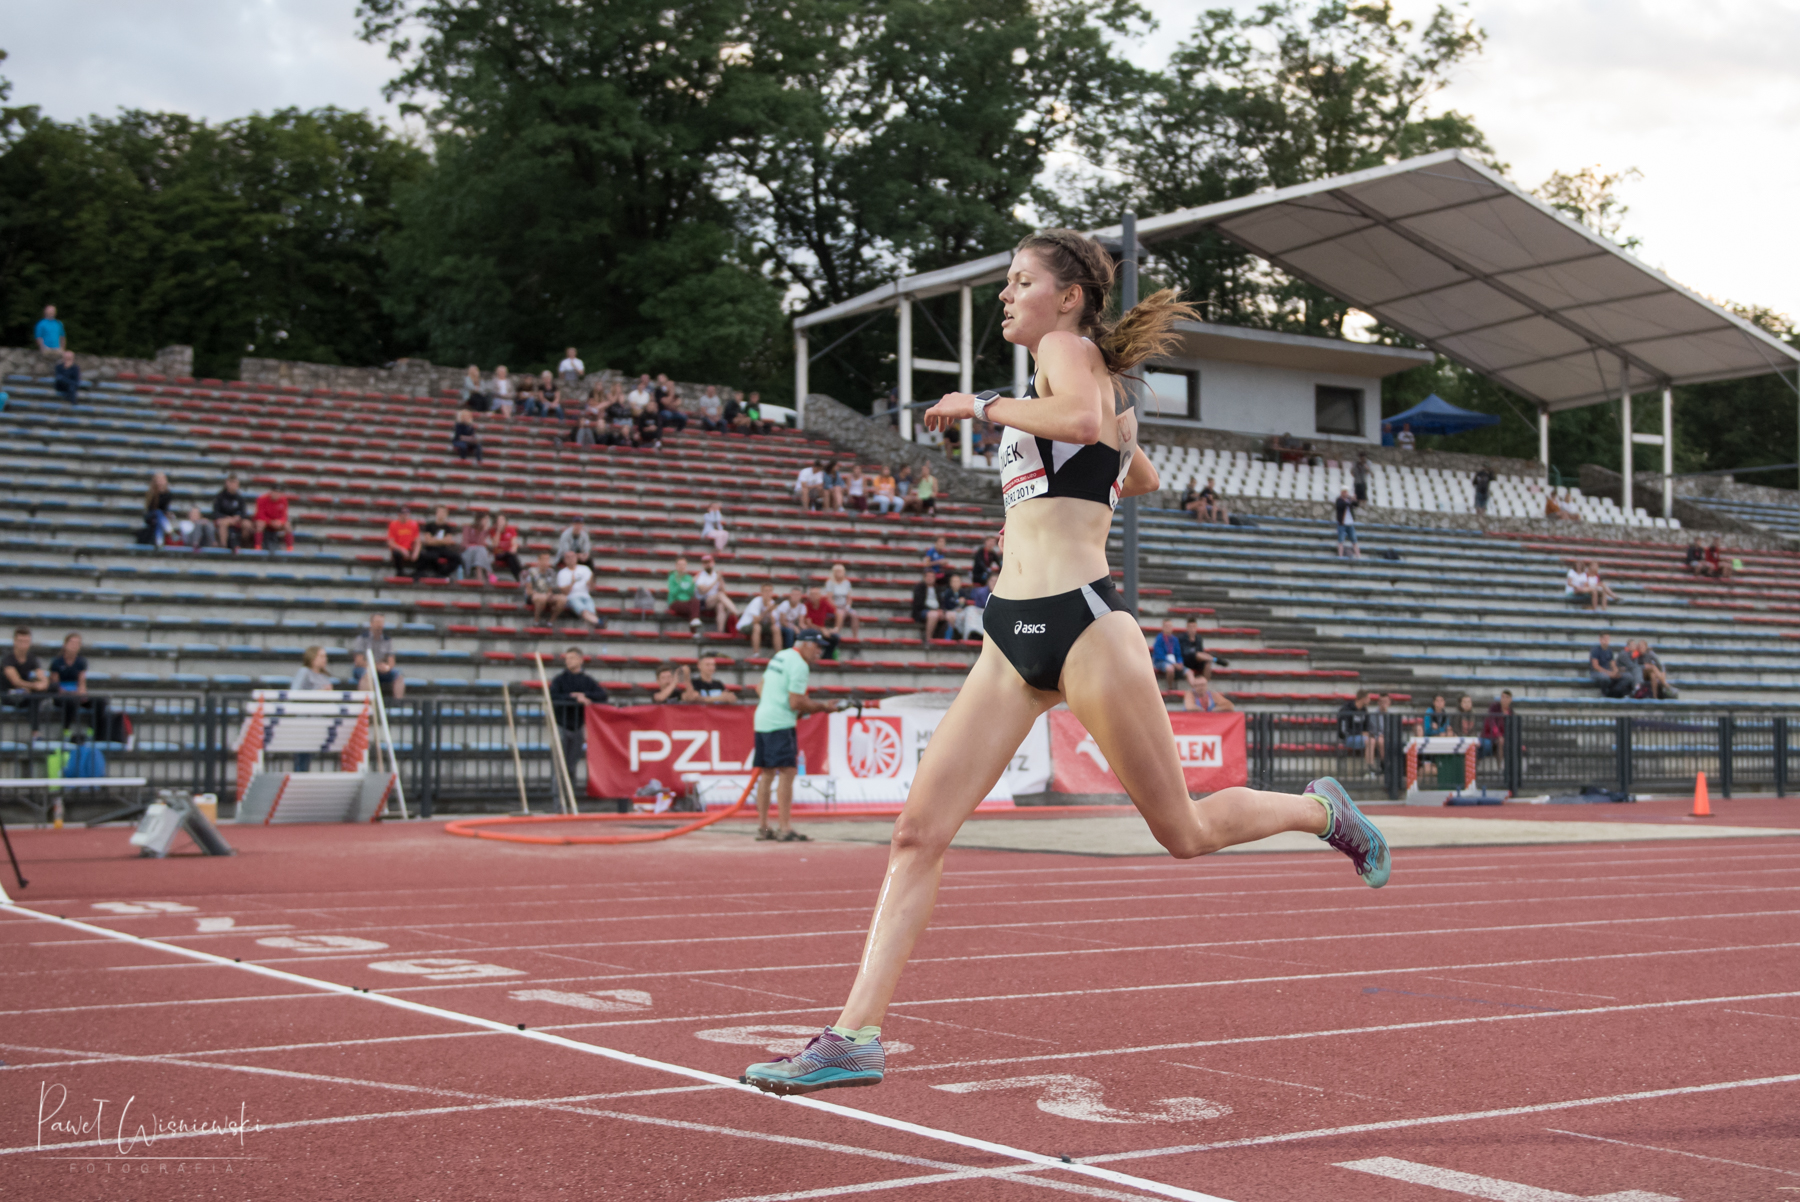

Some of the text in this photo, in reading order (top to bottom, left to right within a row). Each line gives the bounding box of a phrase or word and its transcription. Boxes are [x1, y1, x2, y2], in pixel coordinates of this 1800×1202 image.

[1016, 483, 1036, 499] 2019
[629, 730, 755, 772] PZL
[1175, 741, 1216, 761] LEN
[931, 1073, 1235, 1125] 2
